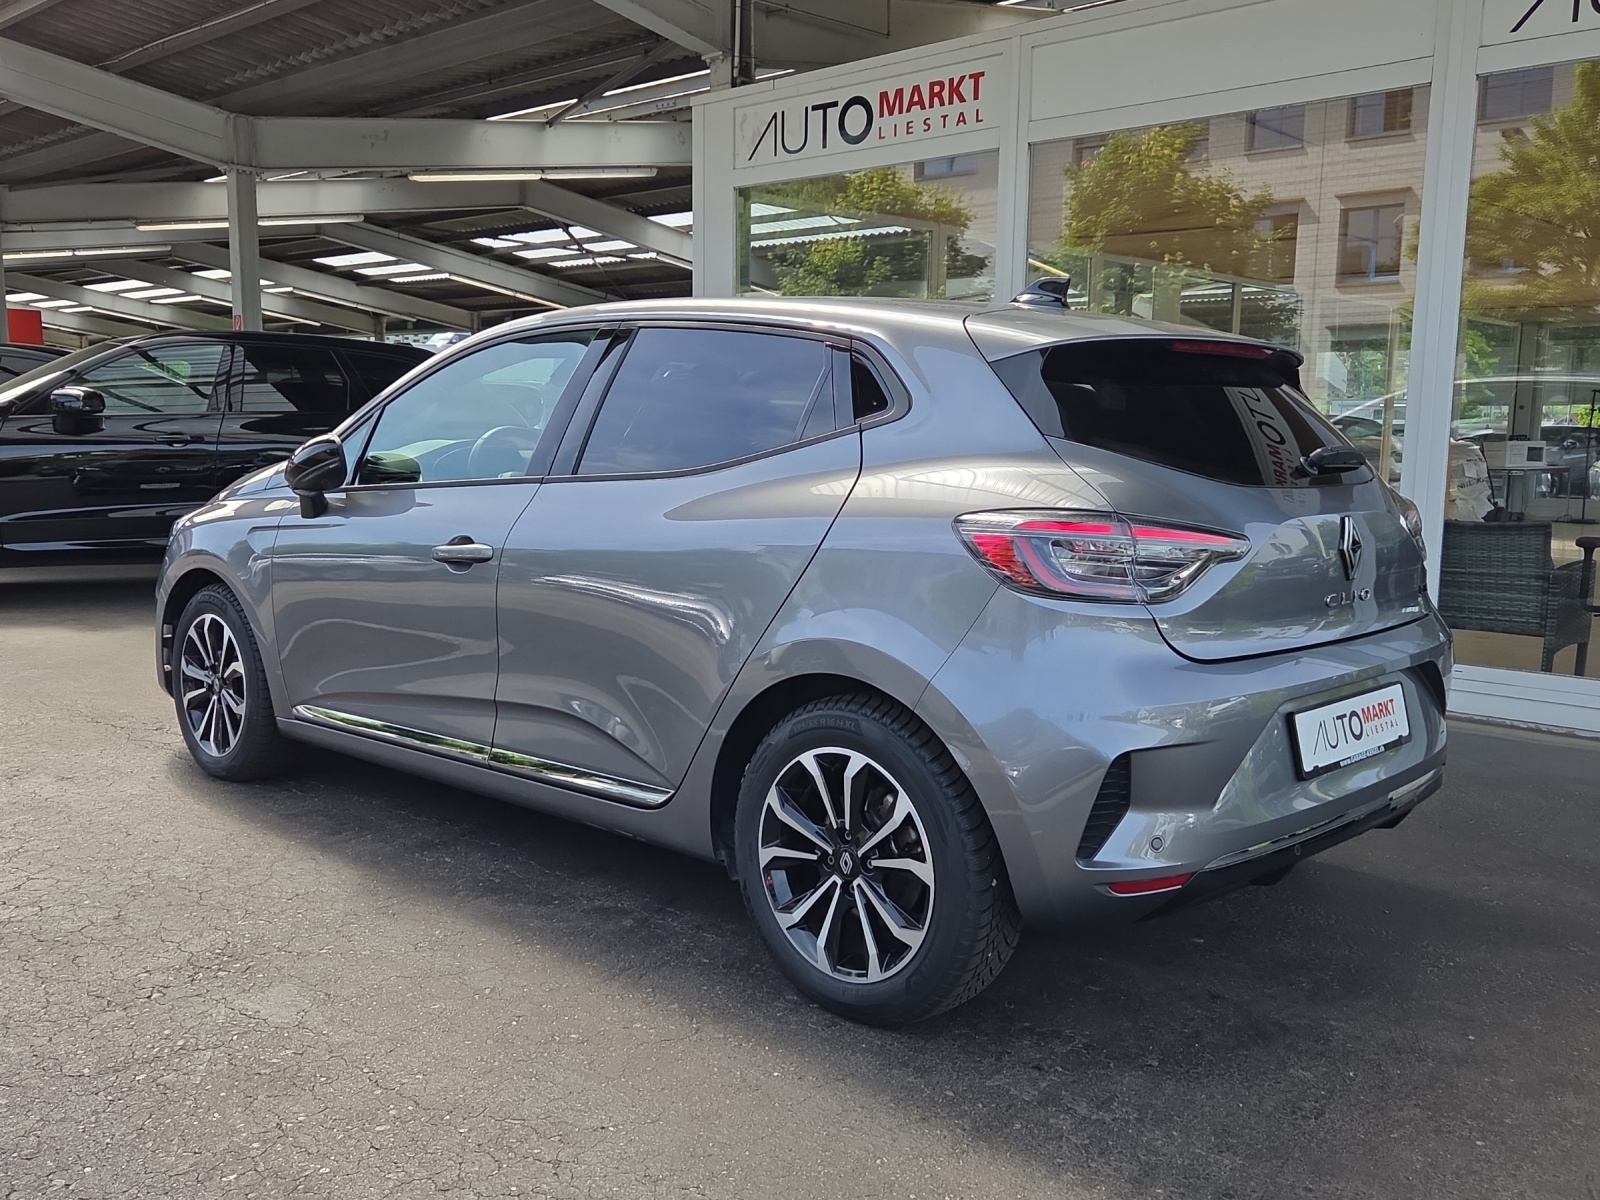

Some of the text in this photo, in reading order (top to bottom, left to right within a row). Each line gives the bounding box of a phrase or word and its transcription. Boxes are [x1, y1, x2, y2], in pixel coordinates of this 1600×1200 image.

[748, 71, 985, 161] AUTO MARKT
[878, 108, 984, 140] LIESTAL
[1324, 587, 1371, 608] CLIO
[1313, 698, 1396, 756] AUTO MARKT
[1365, 718, 1399, 737] LIESTAL
